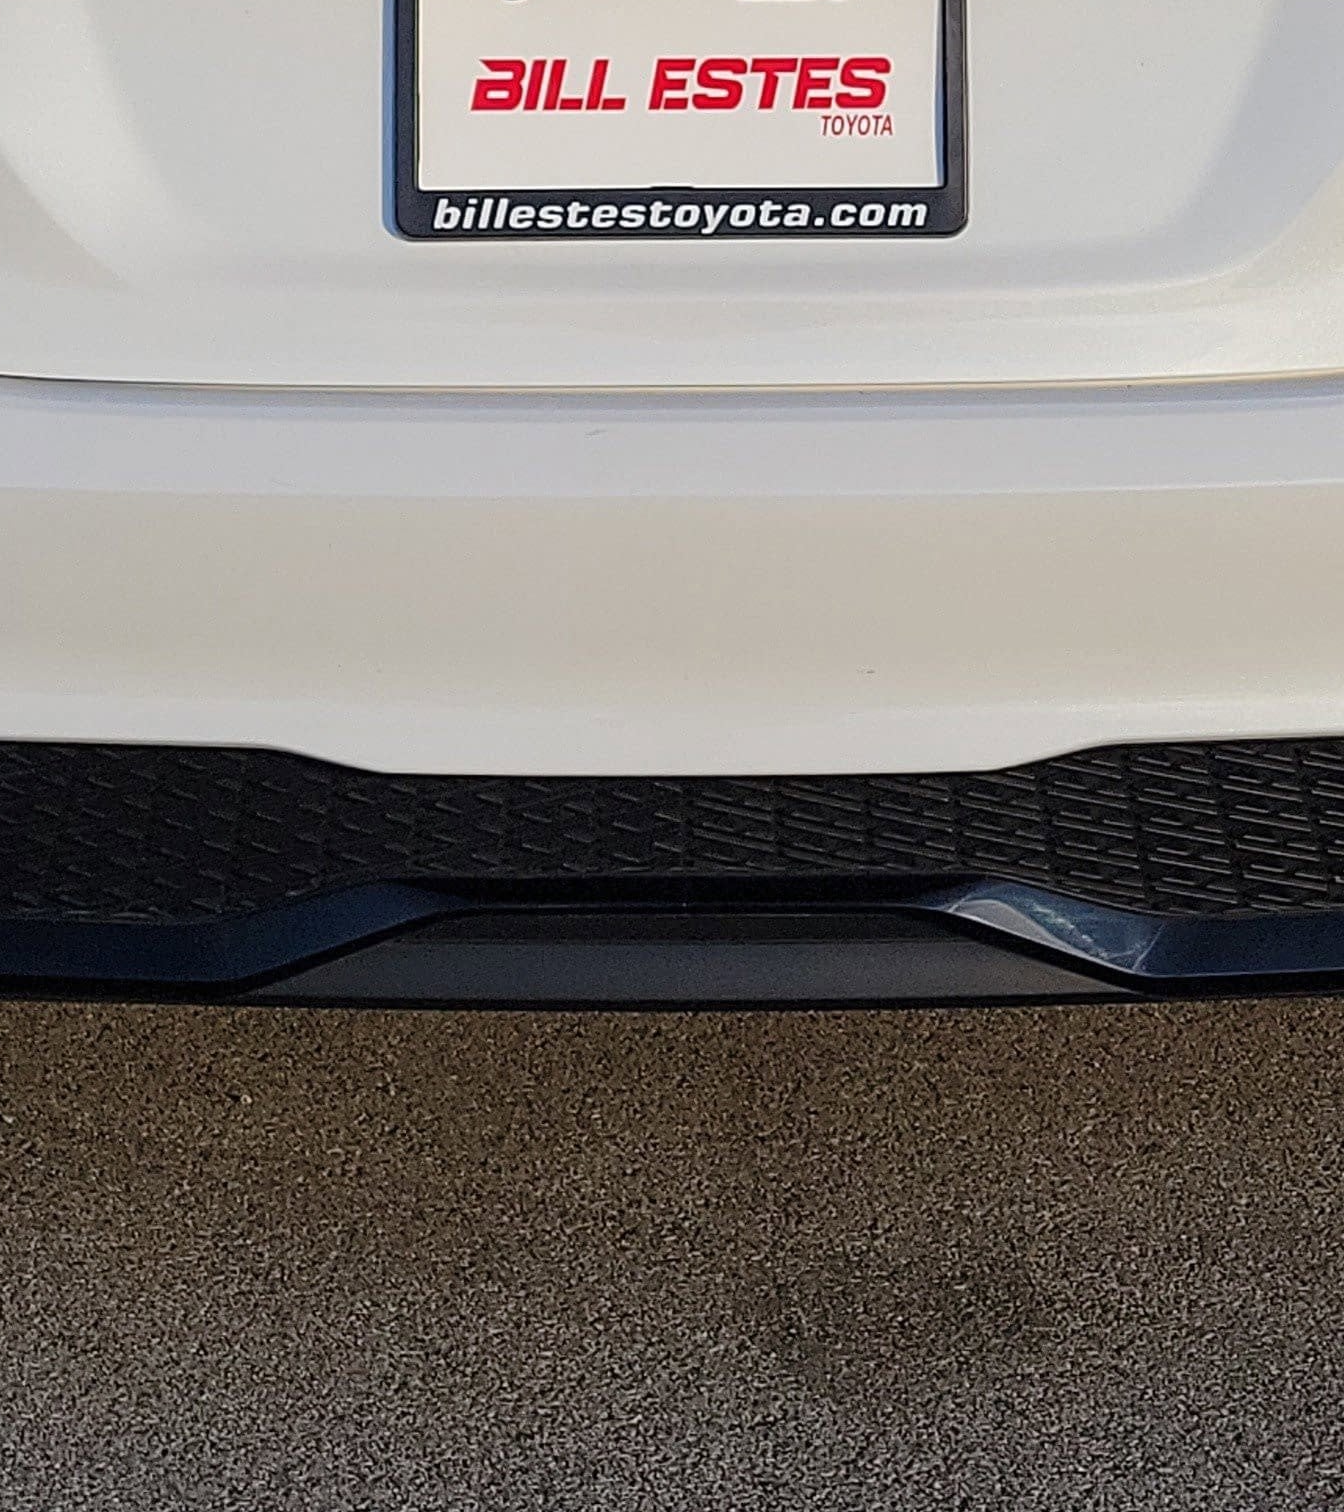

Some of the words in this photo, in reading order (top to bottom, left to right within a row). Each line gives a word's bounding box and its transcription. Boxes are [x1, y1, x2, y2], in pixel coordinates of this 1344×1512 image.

[470, 58, 627, 112] BILL
[648, 57, 892, 112] ESTES
[820, 114, 894, 136] TOYOTA
[432, 197, 929, 235] billestestoyota.com
